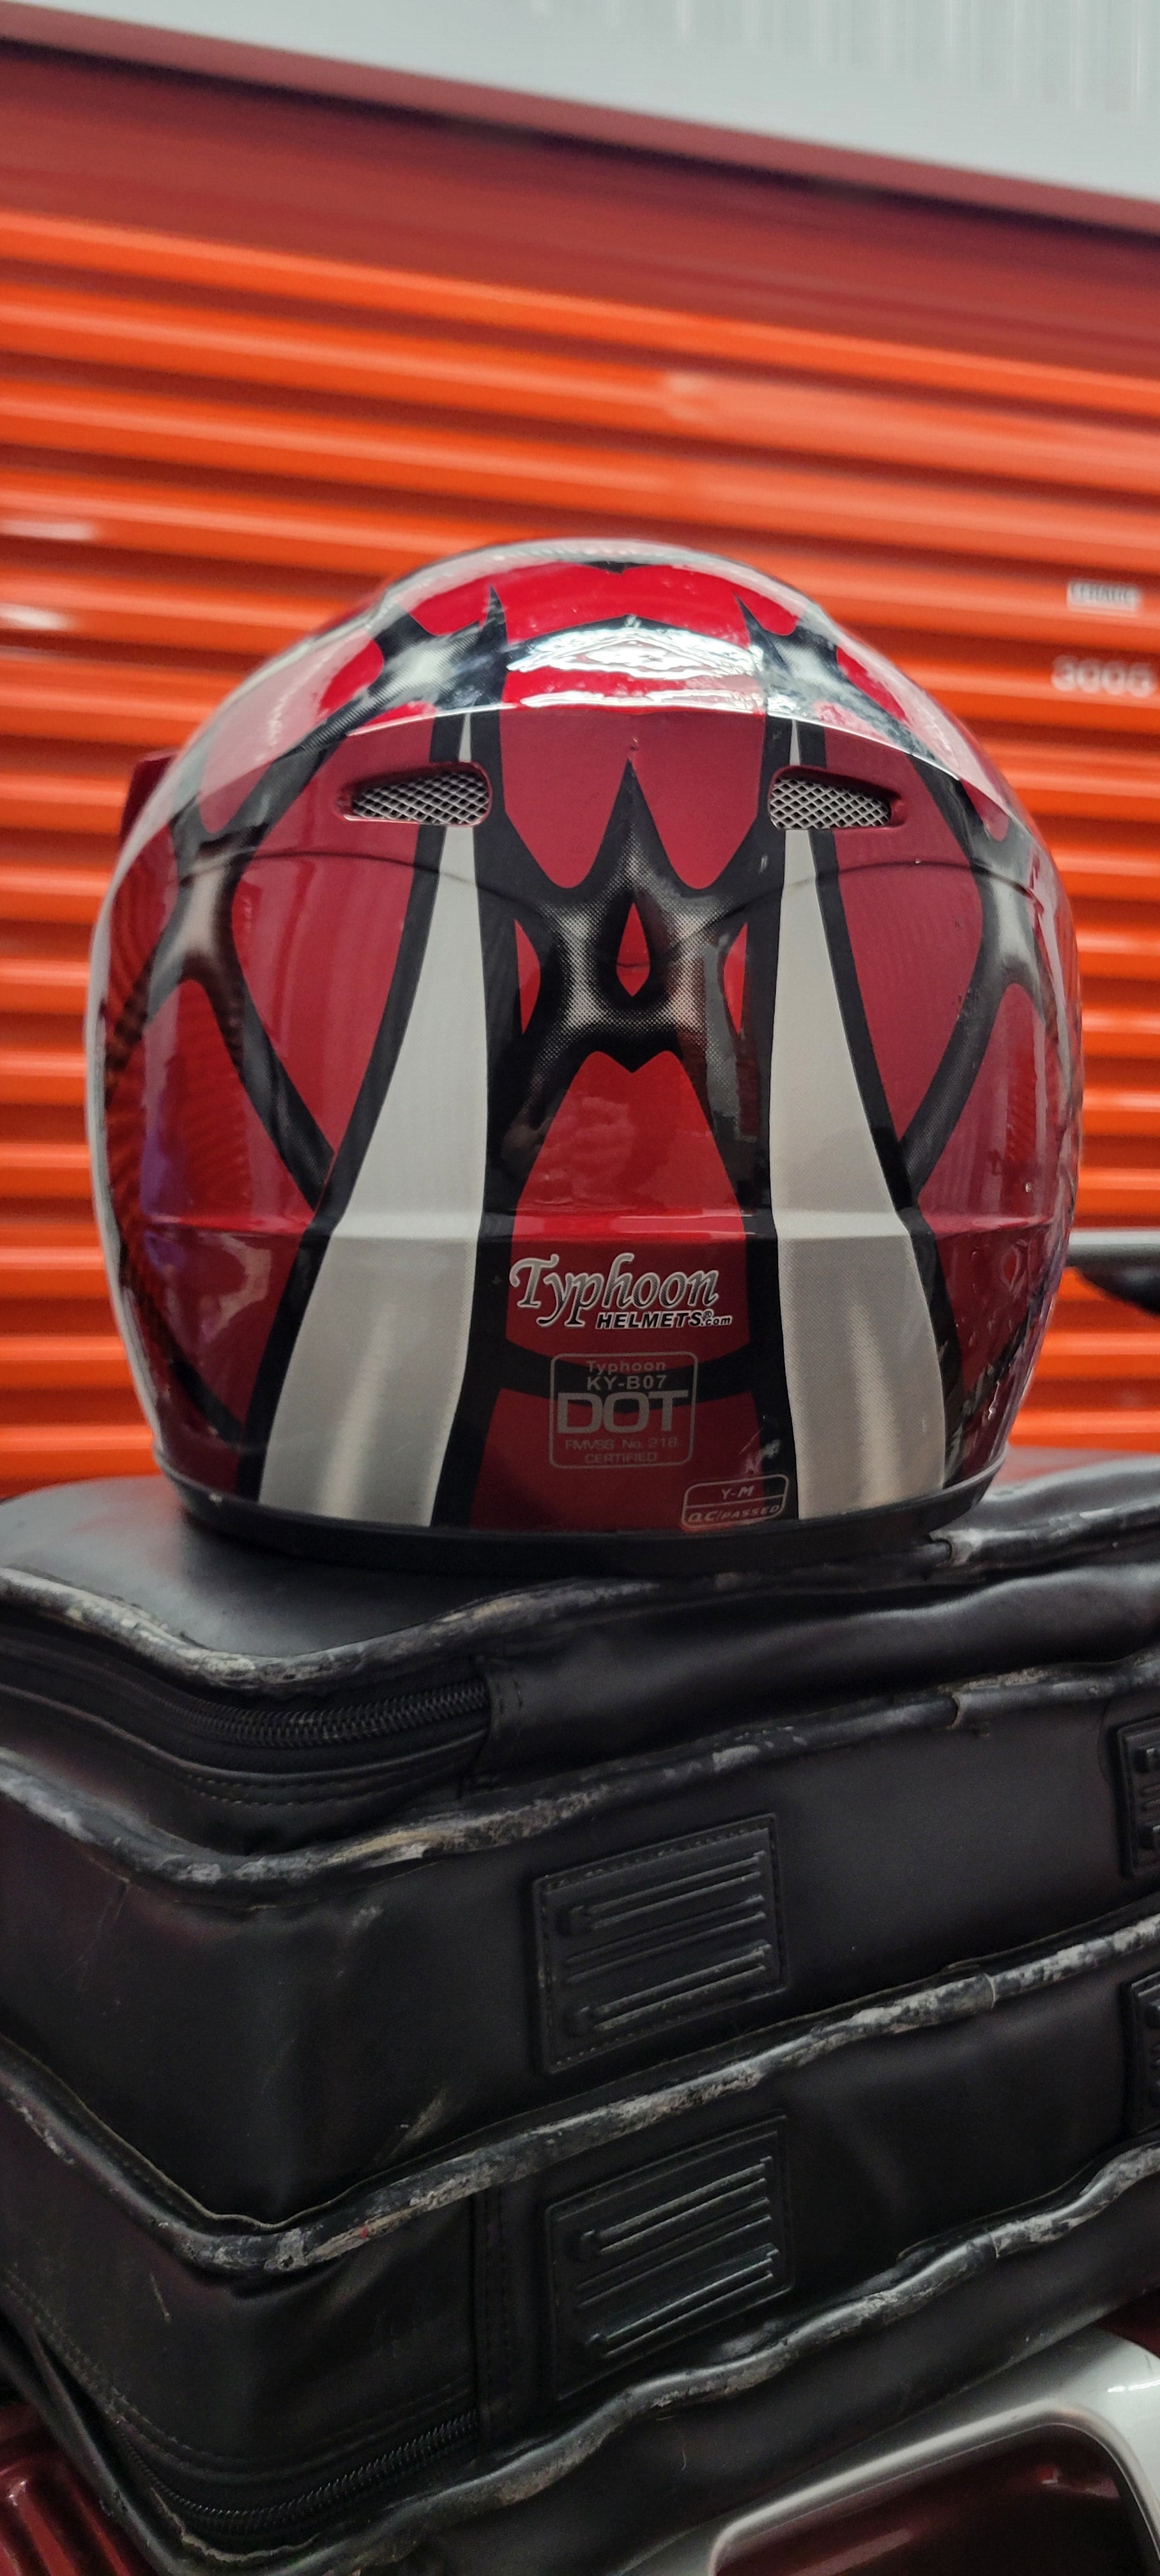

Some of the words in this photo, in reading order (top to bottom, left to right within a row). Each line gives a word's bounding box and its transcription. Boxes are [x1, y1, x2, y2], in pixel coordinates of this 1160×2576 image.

[510, 1253, 719, 1328] Typhoon
[587, 1360, 666, 1375] Typhoon
[587, 1375, 667, 1391] KY-B07
[556, 1390, 689, 1434] DOT
[584, 1452, 657, 1464] CERTIFIED
[721, 1484, 755, 1499] Y-M
